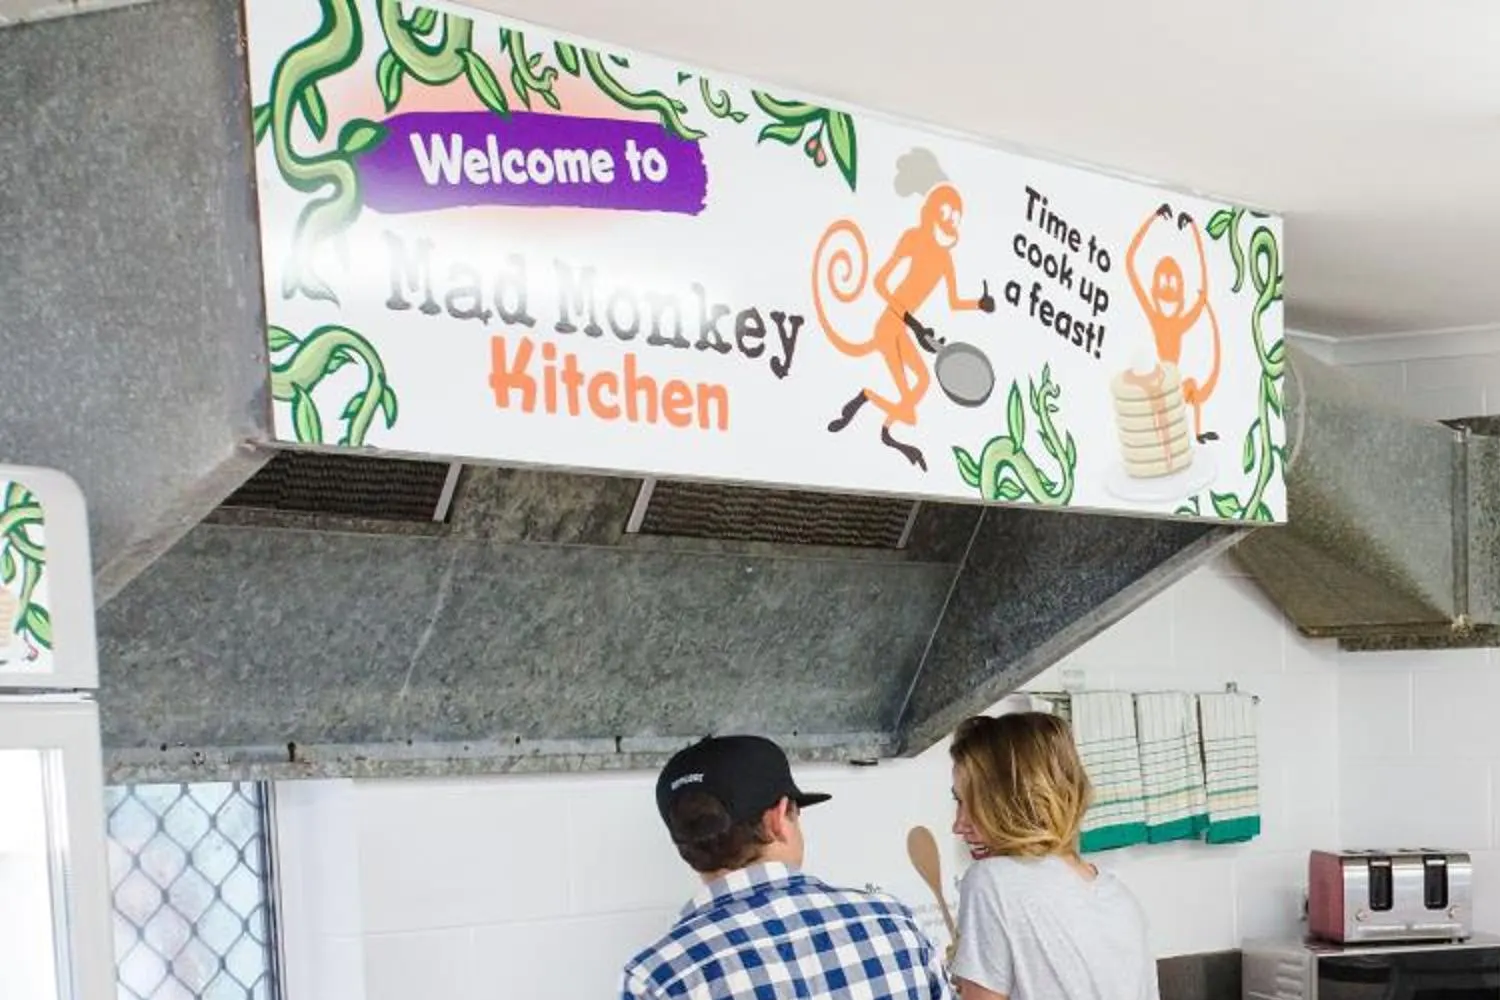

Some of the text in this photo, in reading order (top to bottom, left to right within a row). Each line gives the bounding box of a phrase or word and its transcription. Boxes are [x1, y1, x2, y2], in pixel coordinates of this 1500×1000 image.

[409, 131, 669, 186] Welcome to
[1025, 184, 1112, 274] Time to
[384, 230, 805, 380] Mad Monkey
[1013, 233, 1110, 317] cook up
[1004, 280, 1106, 360] a feast!
[488, 335, 730, 432] Kitchen
